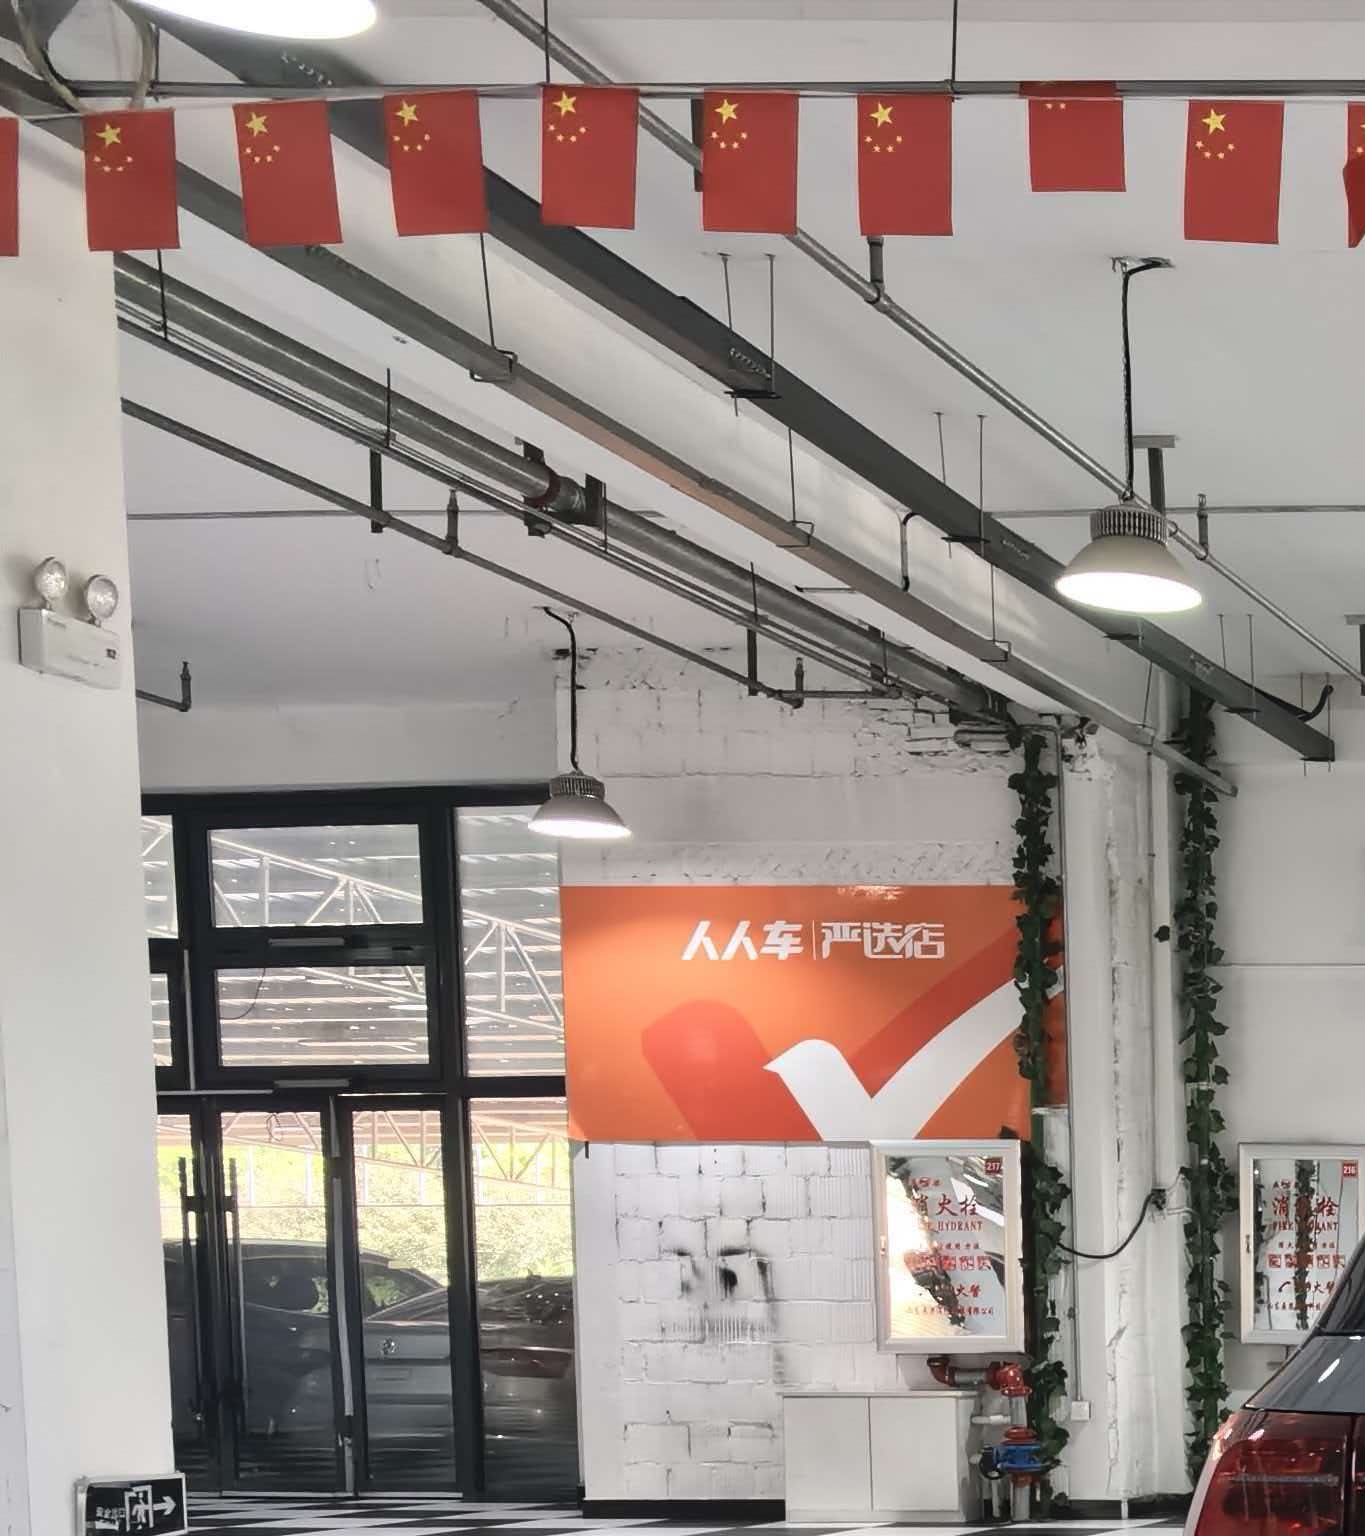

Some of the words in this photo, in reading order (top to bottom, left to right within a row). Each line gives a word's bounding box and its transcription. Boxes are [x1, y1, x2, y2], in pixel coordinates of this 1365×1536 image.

[681, 920, 803, 961] 人人车
[821, 921, 945, 960] 严选店
[938, 1220, 983, 1232] HYDRANT
